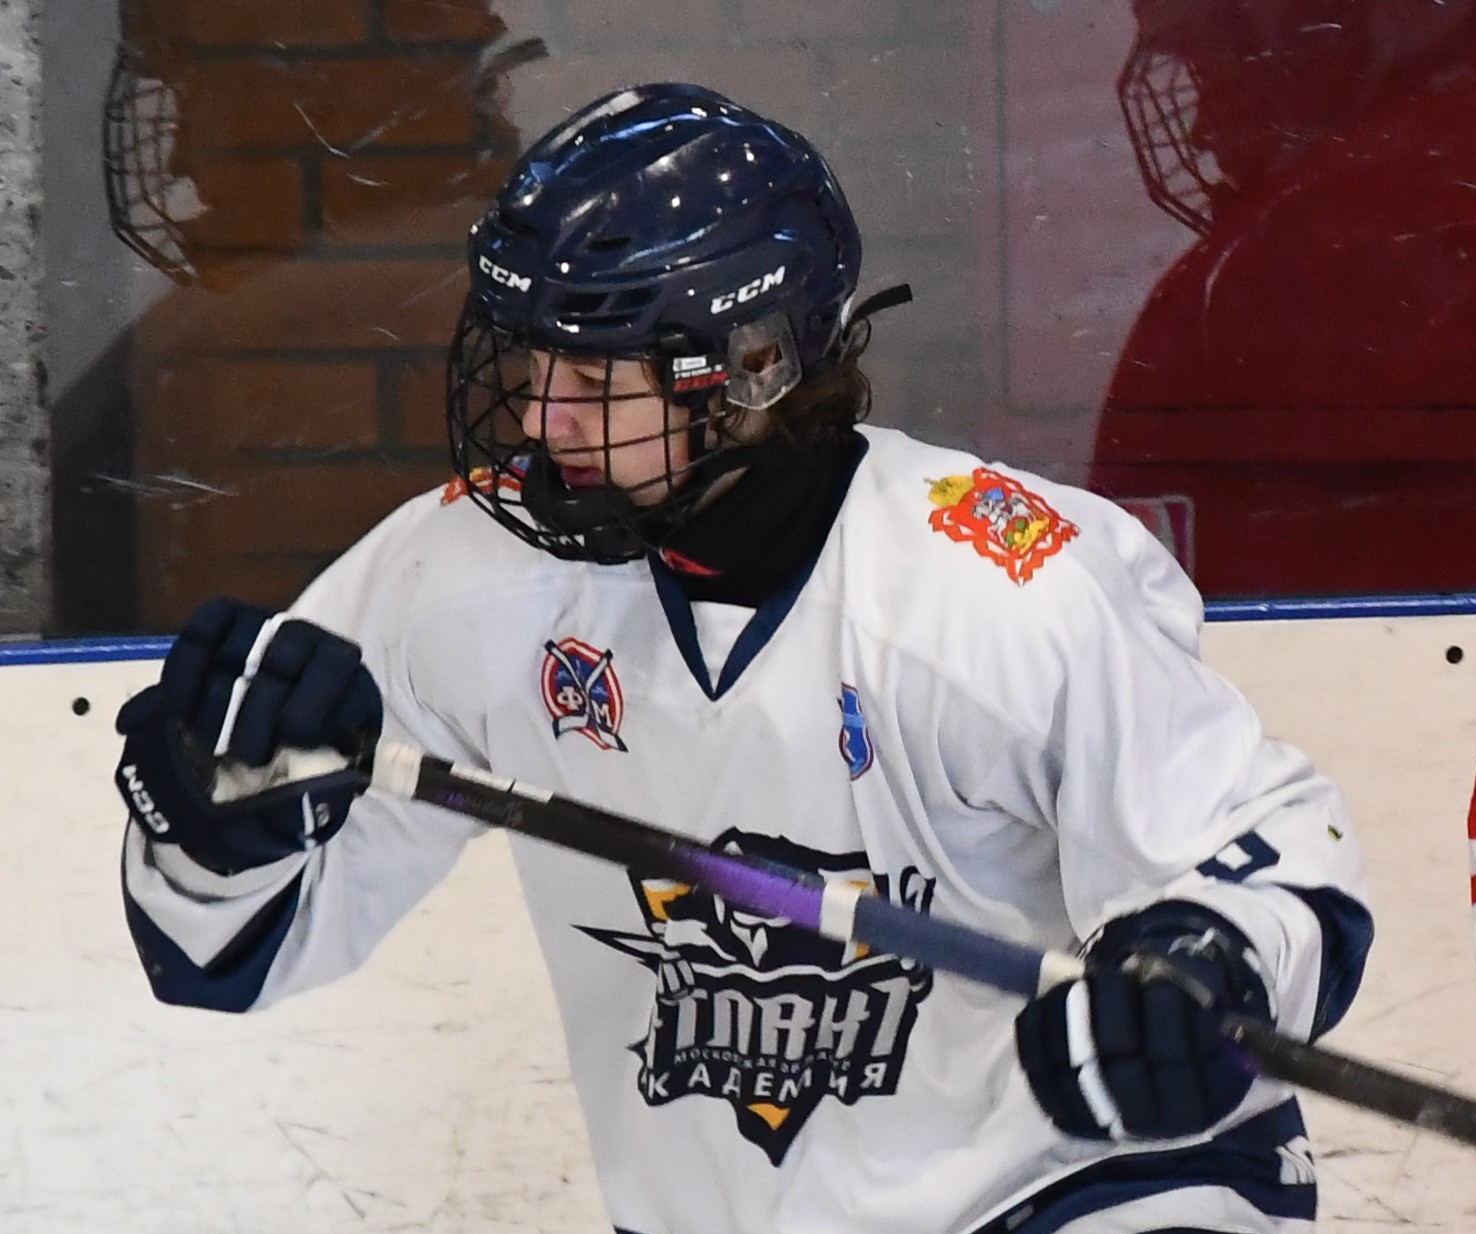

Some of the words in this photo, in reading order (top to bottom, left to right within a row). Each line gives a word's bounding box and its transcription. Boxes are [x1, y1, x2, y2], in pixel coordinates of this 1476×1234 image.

[479, 255, 532, 292] CCM
[711, 265, 786, 315] CCM
[641, 1062, 888, 1103] КАДЕМИЯ
